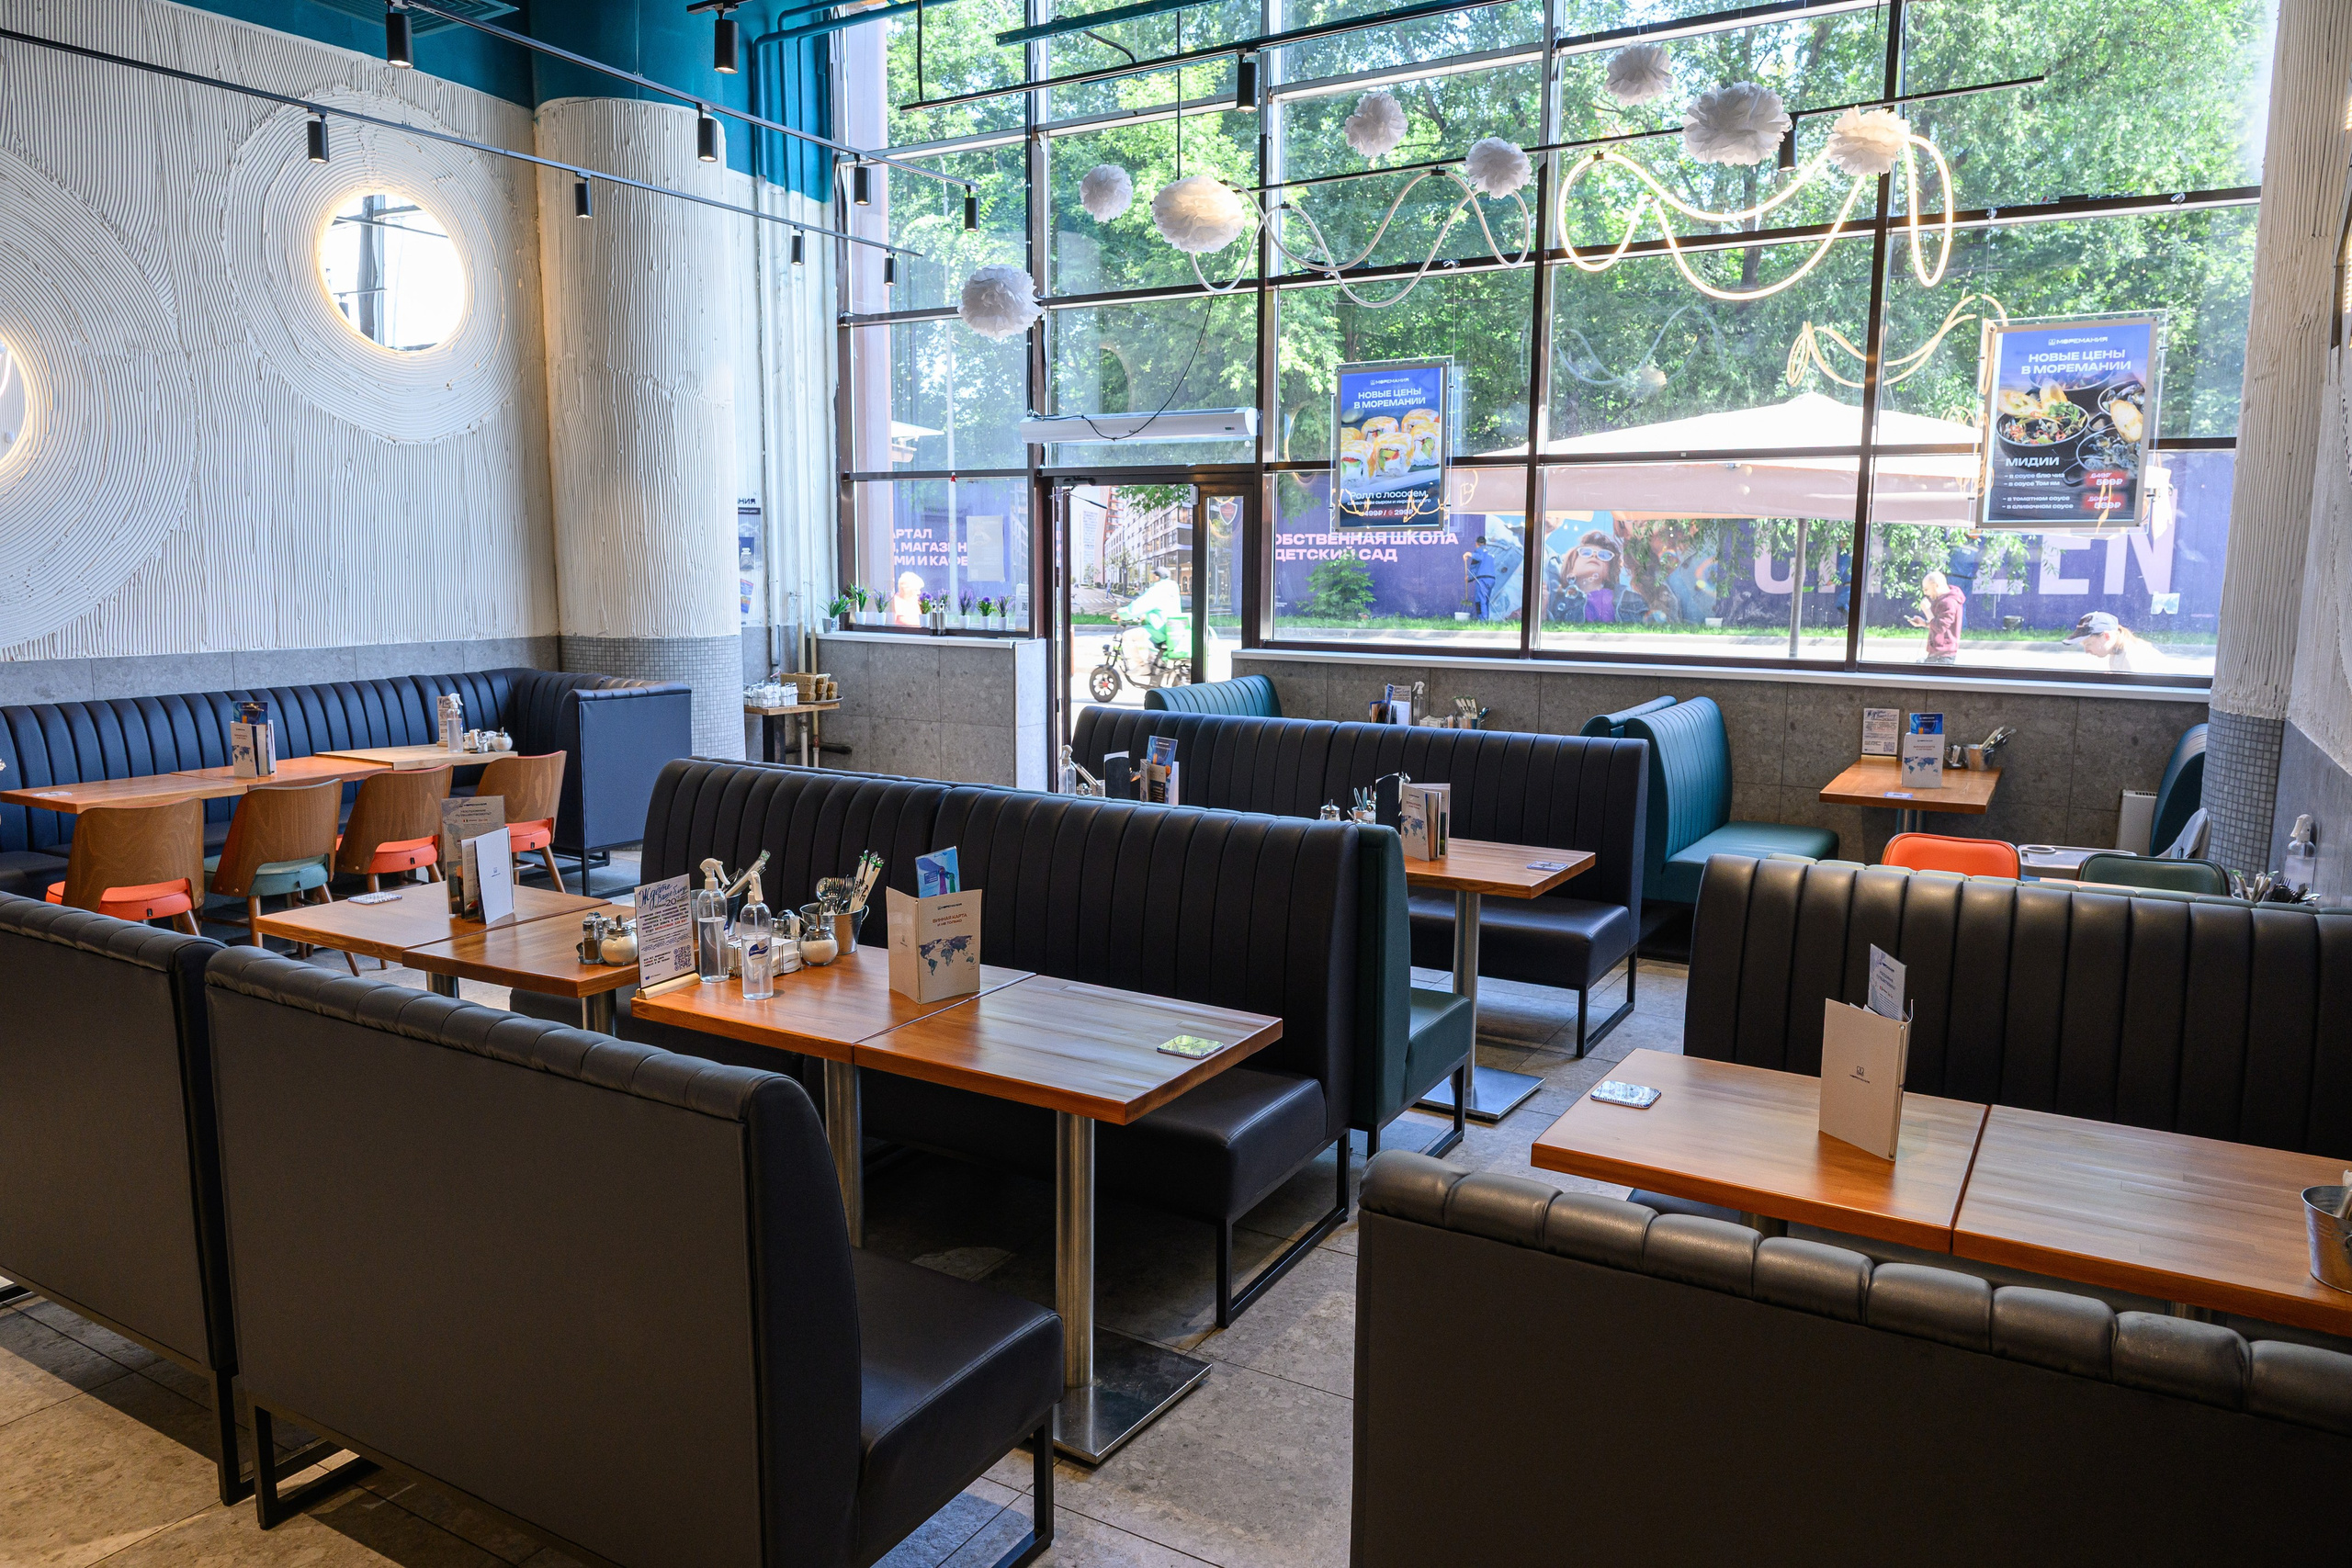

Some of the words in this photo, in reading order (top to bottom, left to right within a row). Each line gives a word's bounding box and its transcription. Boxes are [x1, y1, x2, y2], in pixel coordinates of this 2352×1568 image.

[2056, 336, 2109, 344] МОРЕМАНИЯ
[2028, 352, 2080, 363] НОВЫЕ
[2082, 349, 2125, 361] ЦЕНЫ
[2021, 366, 2030, 375] В
[2033, 361, 2132, 375] МОРЕМАНИИ
[1358, 389, 1392, 400] НОВЫЕ
[1393, 388, 1421, 397] ЦЕНЫ
[1362, 397, 1426, 409] МОРЕМАНИИ
[2005, 457, 2060, 468] МИДИИ
[1390, 531, 1459, 545] ШКОЛА
[900, 541, 967, 553] МАГАЗН
[1275, 546, 1356, 562] ДЕТСКИЙ
[1358, 548, 1398, 562] САД
[917, 555, 928, 566] И
[665, 897, 677, 907] 20
